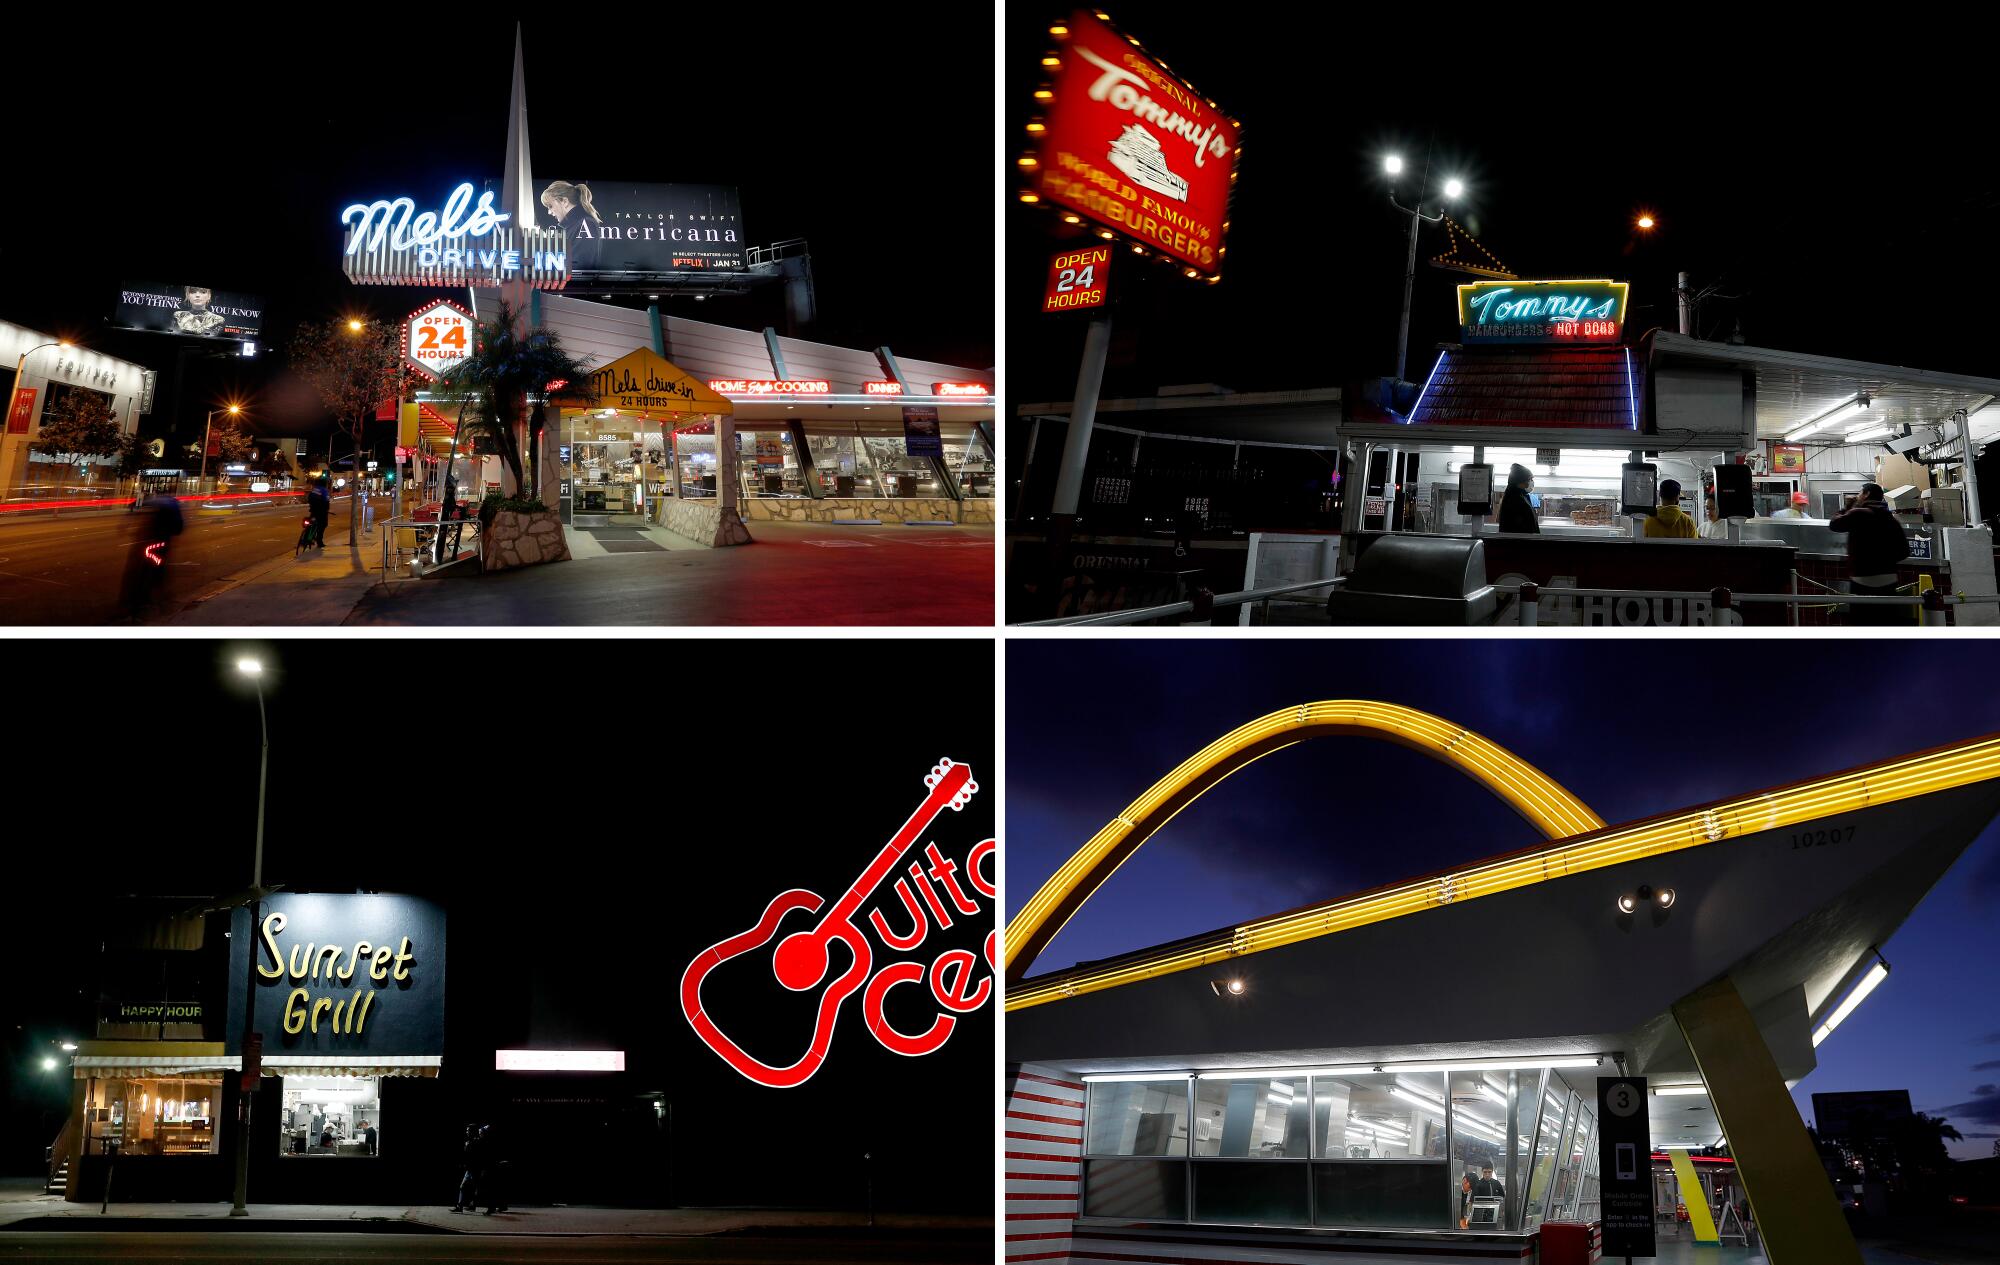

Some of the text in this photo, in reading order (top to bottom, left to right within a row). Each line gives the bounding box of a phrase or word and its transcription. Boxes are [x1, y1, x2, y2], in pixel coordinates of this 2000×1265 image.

[1123, 53, 1201, 118] ORIGINAL
[1072, 44, 1231, 168] Tommy's
[1057, 151, 1211, 240] WORLD FAMOUS
[342, 182, 511, 255] Mels
[616, 212, 674, 220] TAYLOR
[1042, 169, 1214, 265] HAMBURGERS
[576, 218, 738, 242] Americana
[672, 258, 704, 268] NETFLIX
[713, 259, 730, 268] JAN
[1055, 249, 1107, 269] OPEN
[1056, 265, 1094, 292] 24
[122, 295, 181, 309] YOU THINK
[1047, 289, 1101, 309] HOURS
[210, 305, 261, 319] YOU KNOW
[423, 317, 462, 325] OPEN
[418, 326, 467, 350] 24
[1556, 321, 1580, 336] HOT
[1584, 321, 1616, 337] DOGS
[416, 350, 465, 359] HOURS
[56, 357, 118, 387] EQUINOX
[592, 368, 642, 396] Mels
[646, 367, 697, 401] drive-in
[710, 381, 746, 392] HOME
[773, 381, 829, 393] COOKING
[867, 383, 902, 394] DINNER
[621, 396, 668, 408] 24 HOURS
[648, 483, 672, 494] Wi-Fi
[1919, 541, 1927, 549] &
[1791, 825, 1857, 850] 10207
[256, 911, 414, 981] Sunset
[121, 1005, 203, 1017] HAPPY HOUR
[283, 987, 375, 1035] Grill
[1617, 1090, 1630, 1108] 3
